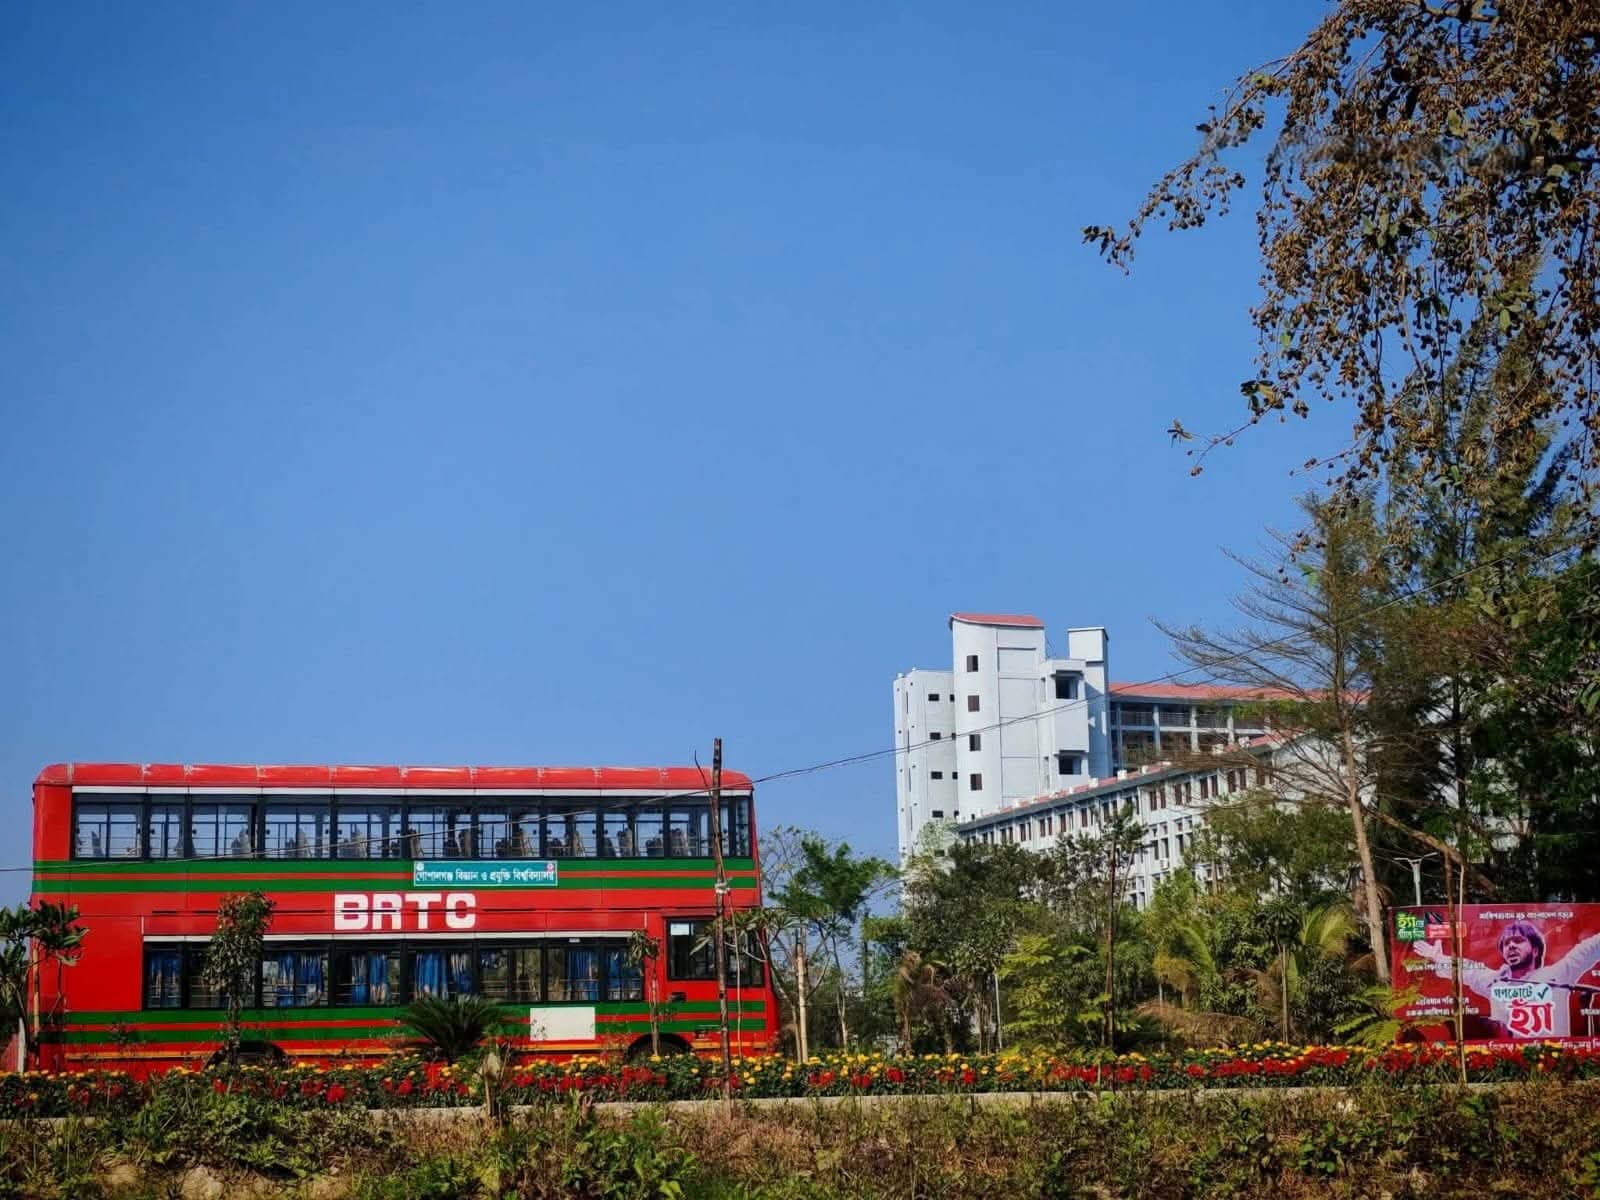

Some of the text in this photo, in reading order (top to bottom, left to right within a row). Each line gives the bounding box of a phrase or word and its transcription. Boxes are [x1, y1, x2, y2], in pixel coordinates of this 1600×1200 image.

[481, 871, 487, 881] ও
[334, 892, 476, 930] BRTC
[1494, 985, 1533, 999] গণভোটে
[1507, 998, 1553, 1036] হ্যাঁ
